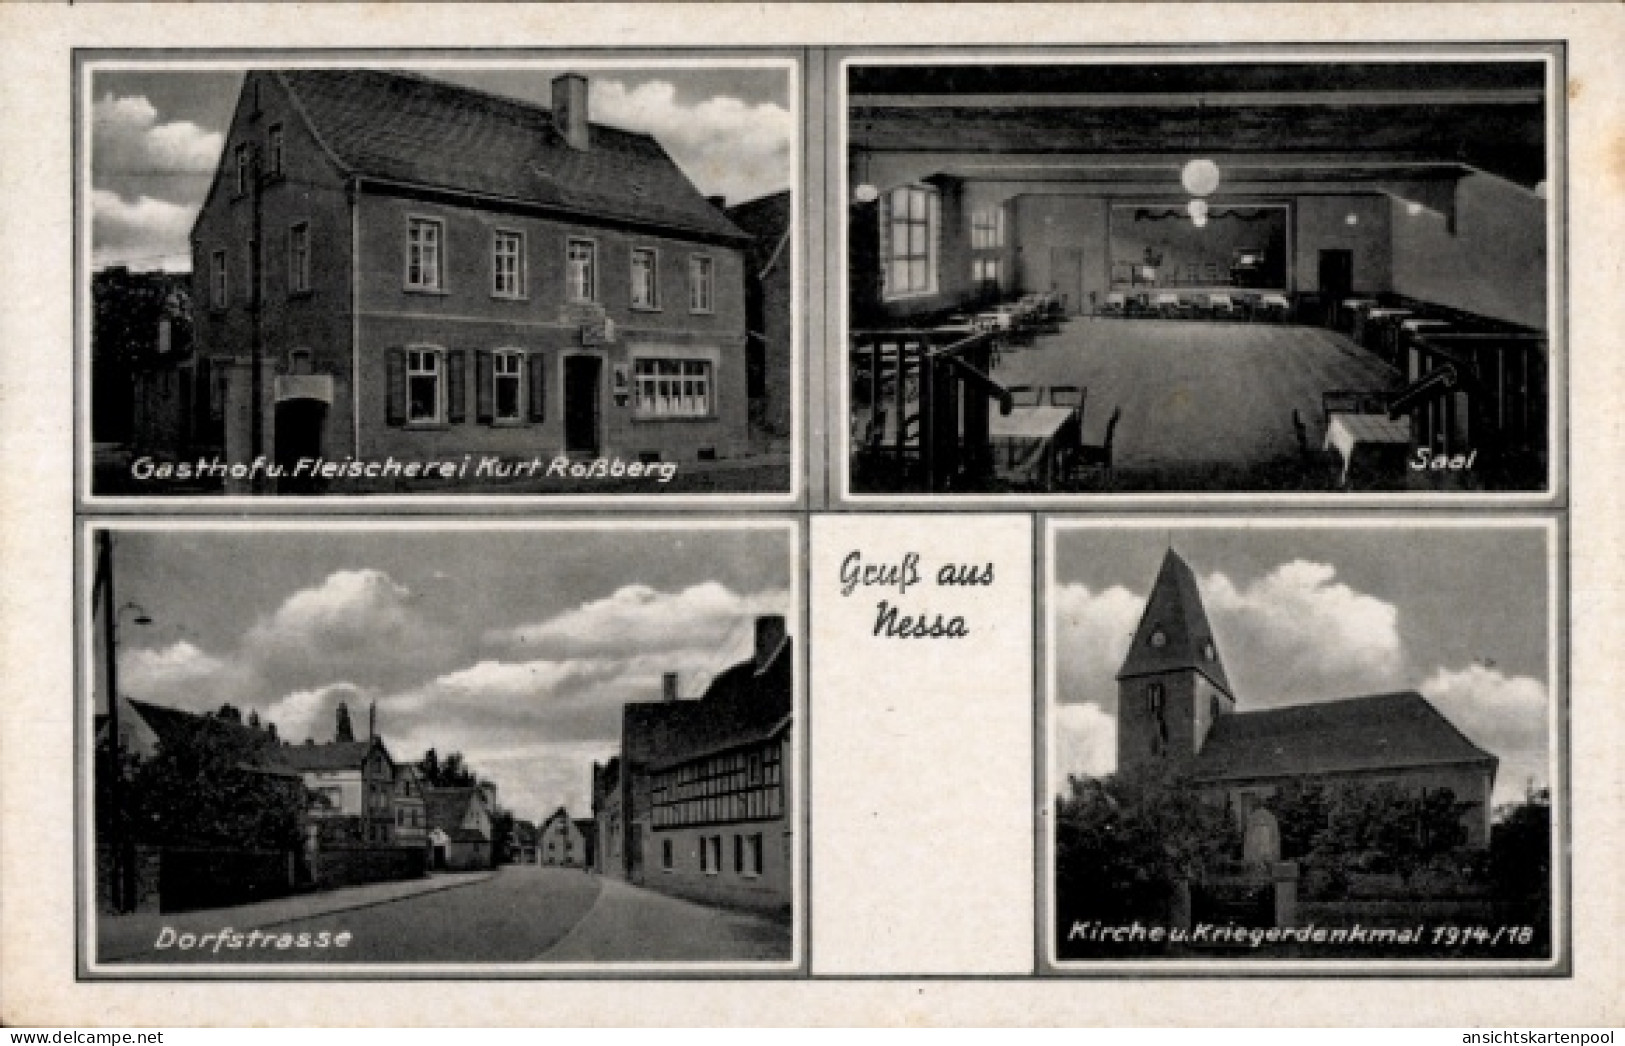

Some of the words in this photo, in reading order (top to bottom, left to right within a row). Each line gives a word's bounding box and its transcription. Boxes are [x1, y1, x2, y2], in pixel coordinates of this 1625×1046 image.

[131, 455, 267, 479] Gasthof
[293, 454, 471, 479] Fleischerei
[475, 455, 542, 478] Kurt
[546, 455, 679, 483] Roßberg
[1408, 446, 1478, 471] Saal
[840, 549, 922, 597] Gruß
[936, 561, 995, 586] aus
[872, 599, 970, 639] Nessa
[154, 926, 354, 954] Dorfstrasse
[1067, 920, 1167, 942] Kirche
[1431, 923, 1534, 946] 1914/18
